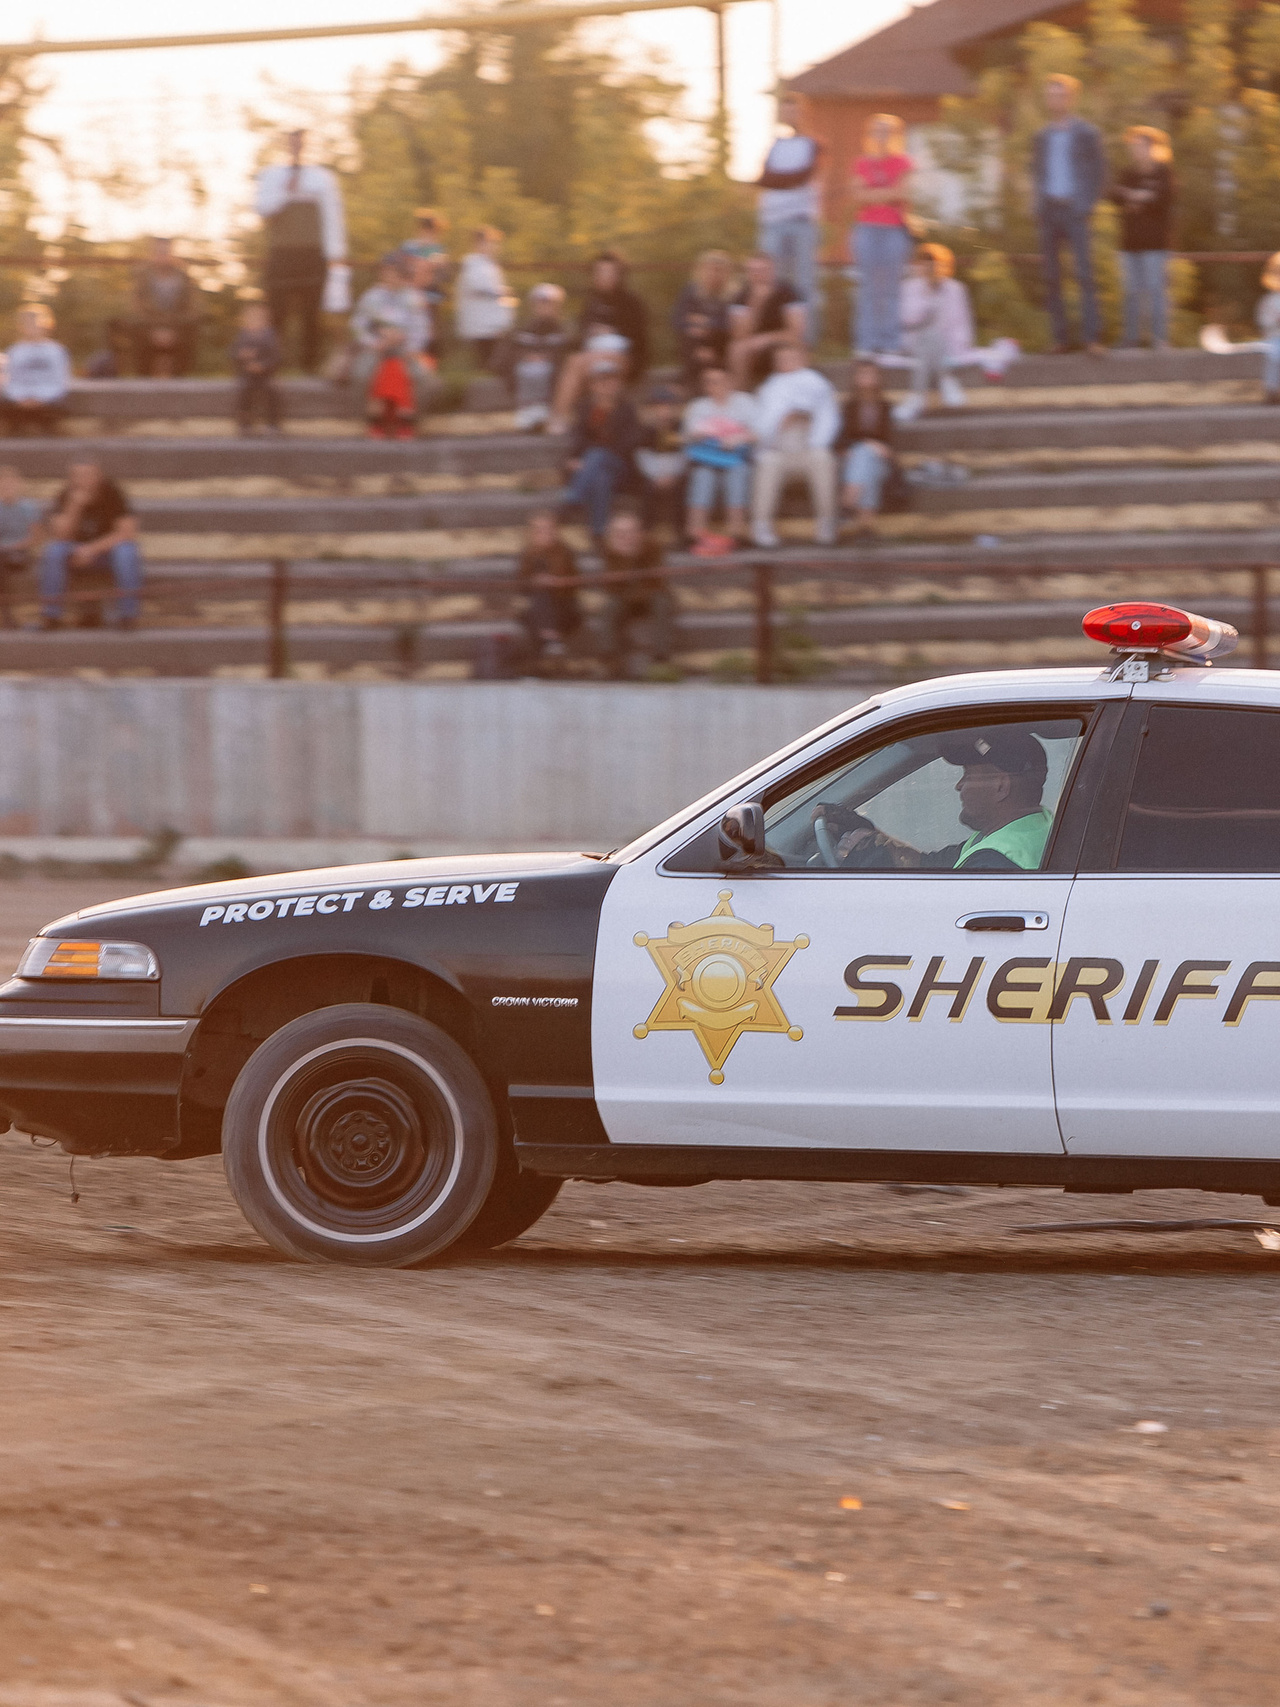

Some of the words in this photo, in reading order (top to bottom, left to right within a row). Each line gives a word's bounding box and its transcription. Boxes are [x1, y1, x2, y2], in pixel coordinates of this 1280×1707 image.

[199, 891, 367, 927] PROTECT
[368, 889, 395, 911] &
[401, 882, 520, 909] SERVE
[491, 996, 530, 1006] CROWN
[532, 997, 579, 1007] VICTORIA
